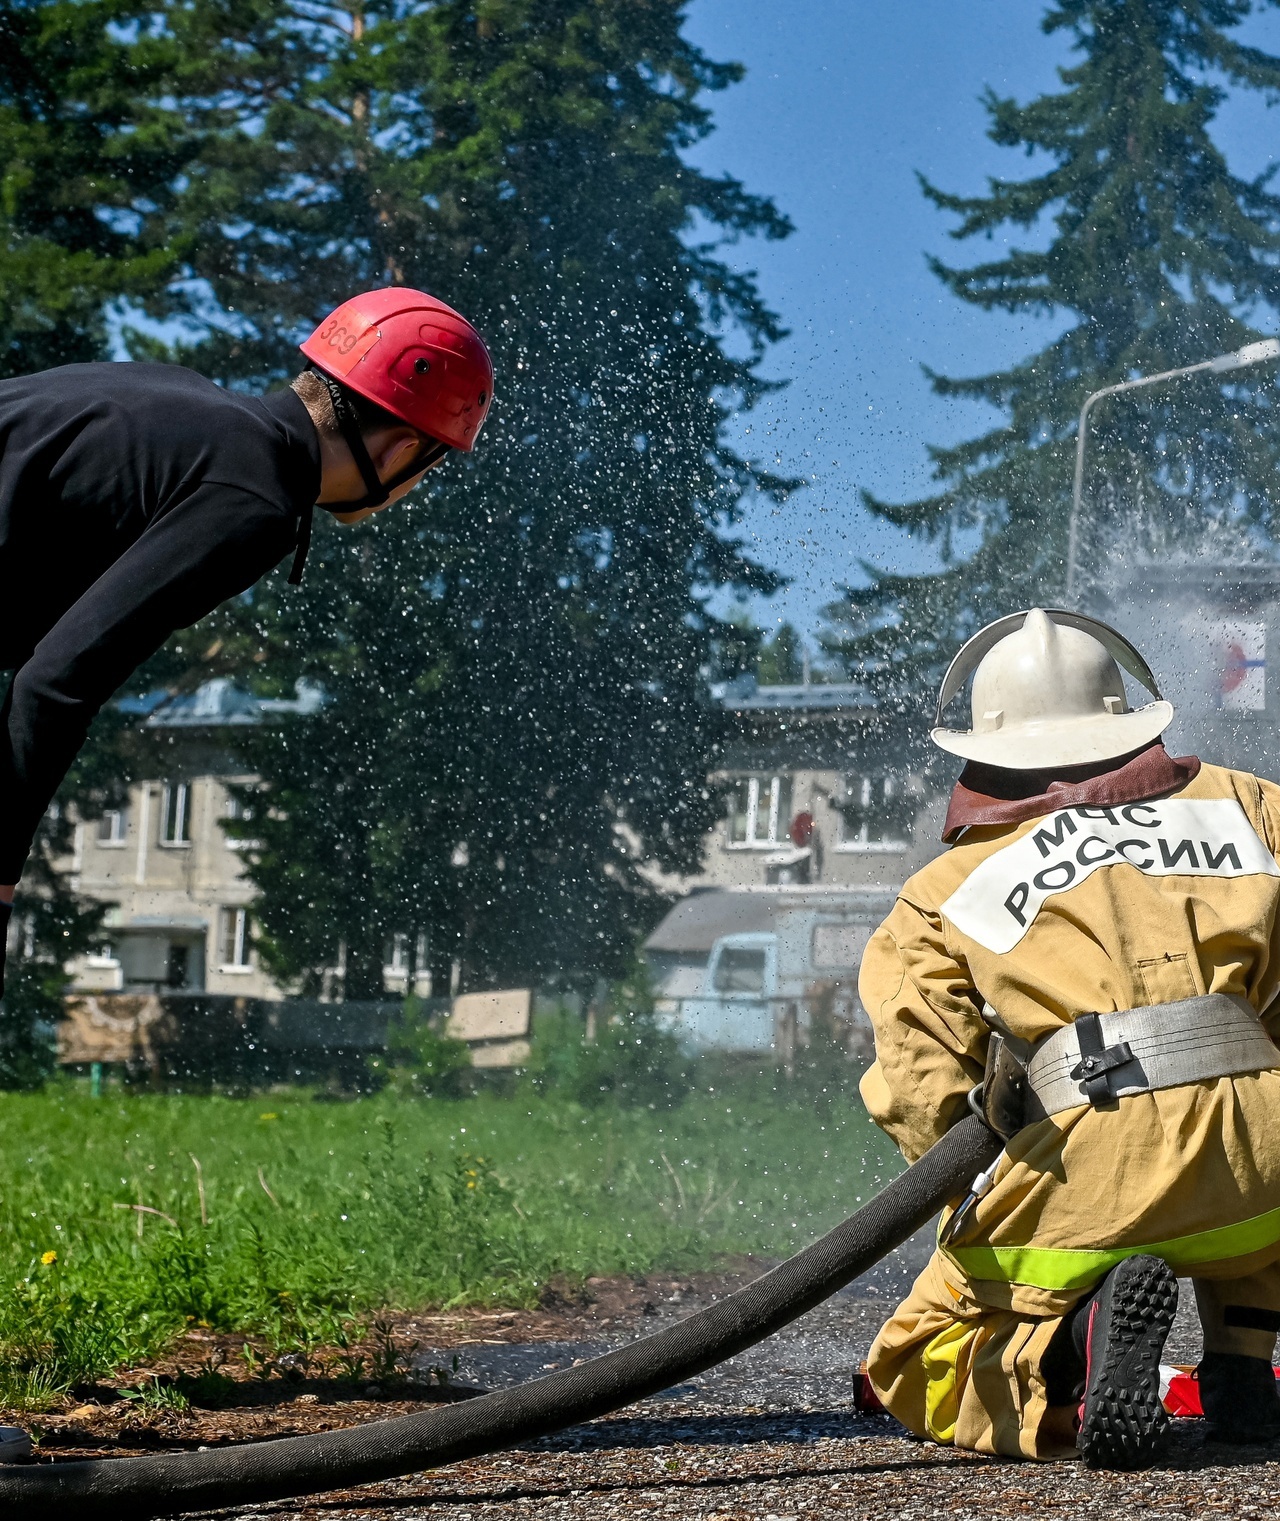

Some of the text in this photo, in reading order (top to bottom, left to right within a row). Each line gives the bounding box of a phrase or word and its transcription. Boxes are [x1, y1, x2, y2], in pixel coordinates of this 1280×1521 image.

[320, 319, 358, 355] 369
[1032, 803, 1162, 858] МЧС
[1003, 836, 1243, 927] РОССИИ
